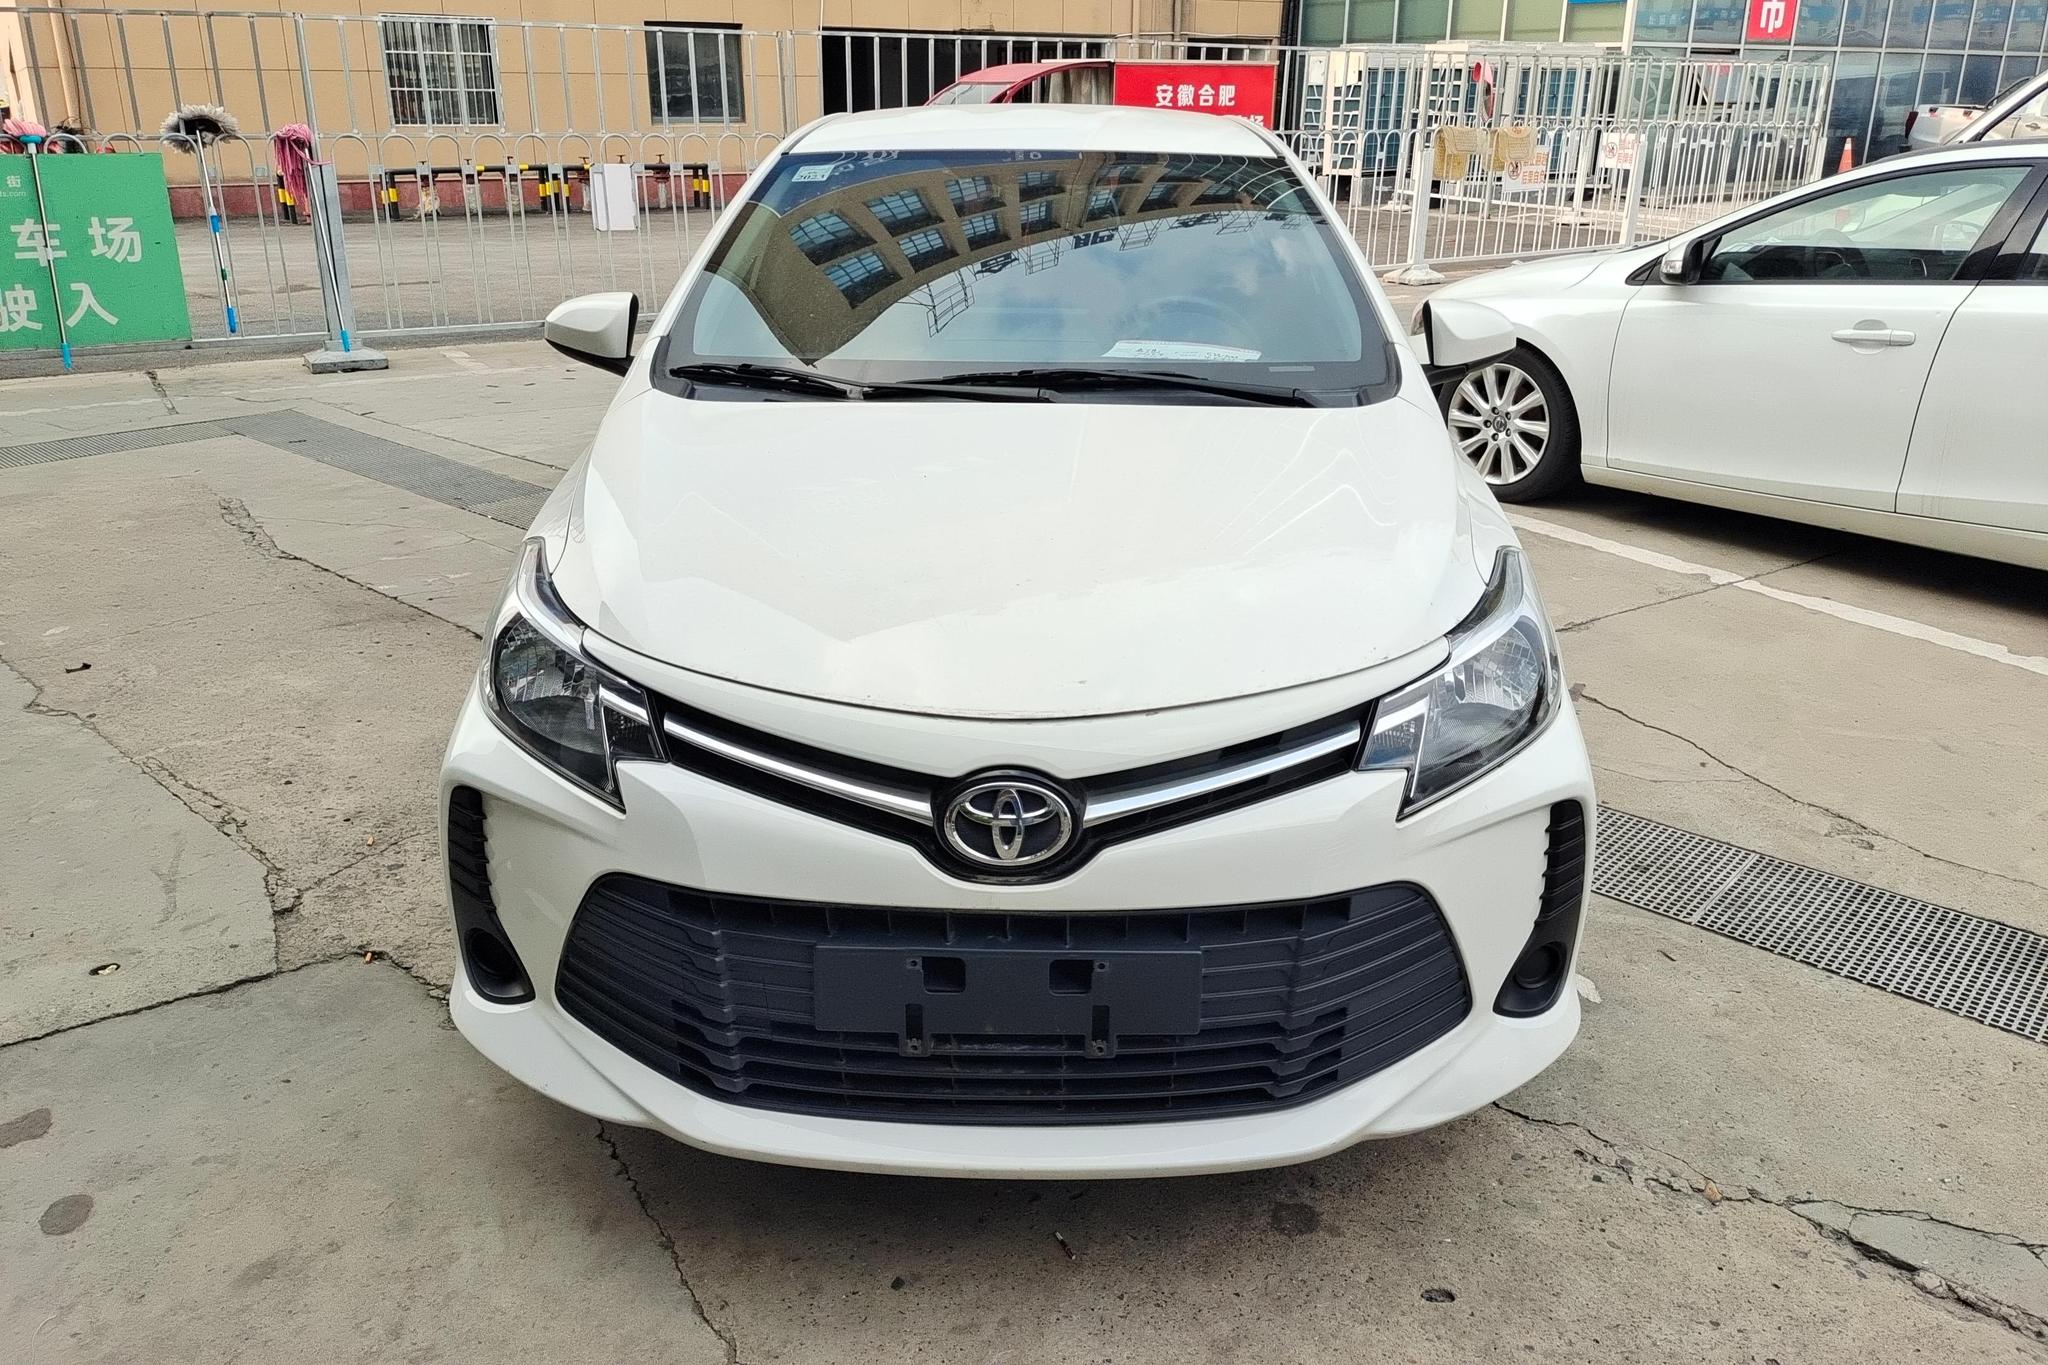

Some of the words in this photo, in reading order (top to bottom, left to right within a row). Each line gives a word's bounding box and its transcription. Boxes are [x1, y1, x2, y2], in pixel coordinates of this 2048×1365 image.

[1156, 84, 1236, 107] 安徽合肥
[6, 175, 21, 188] 街
[10, 216, 142, 267] 车场
[0, 283, 119, 332] 驶入
